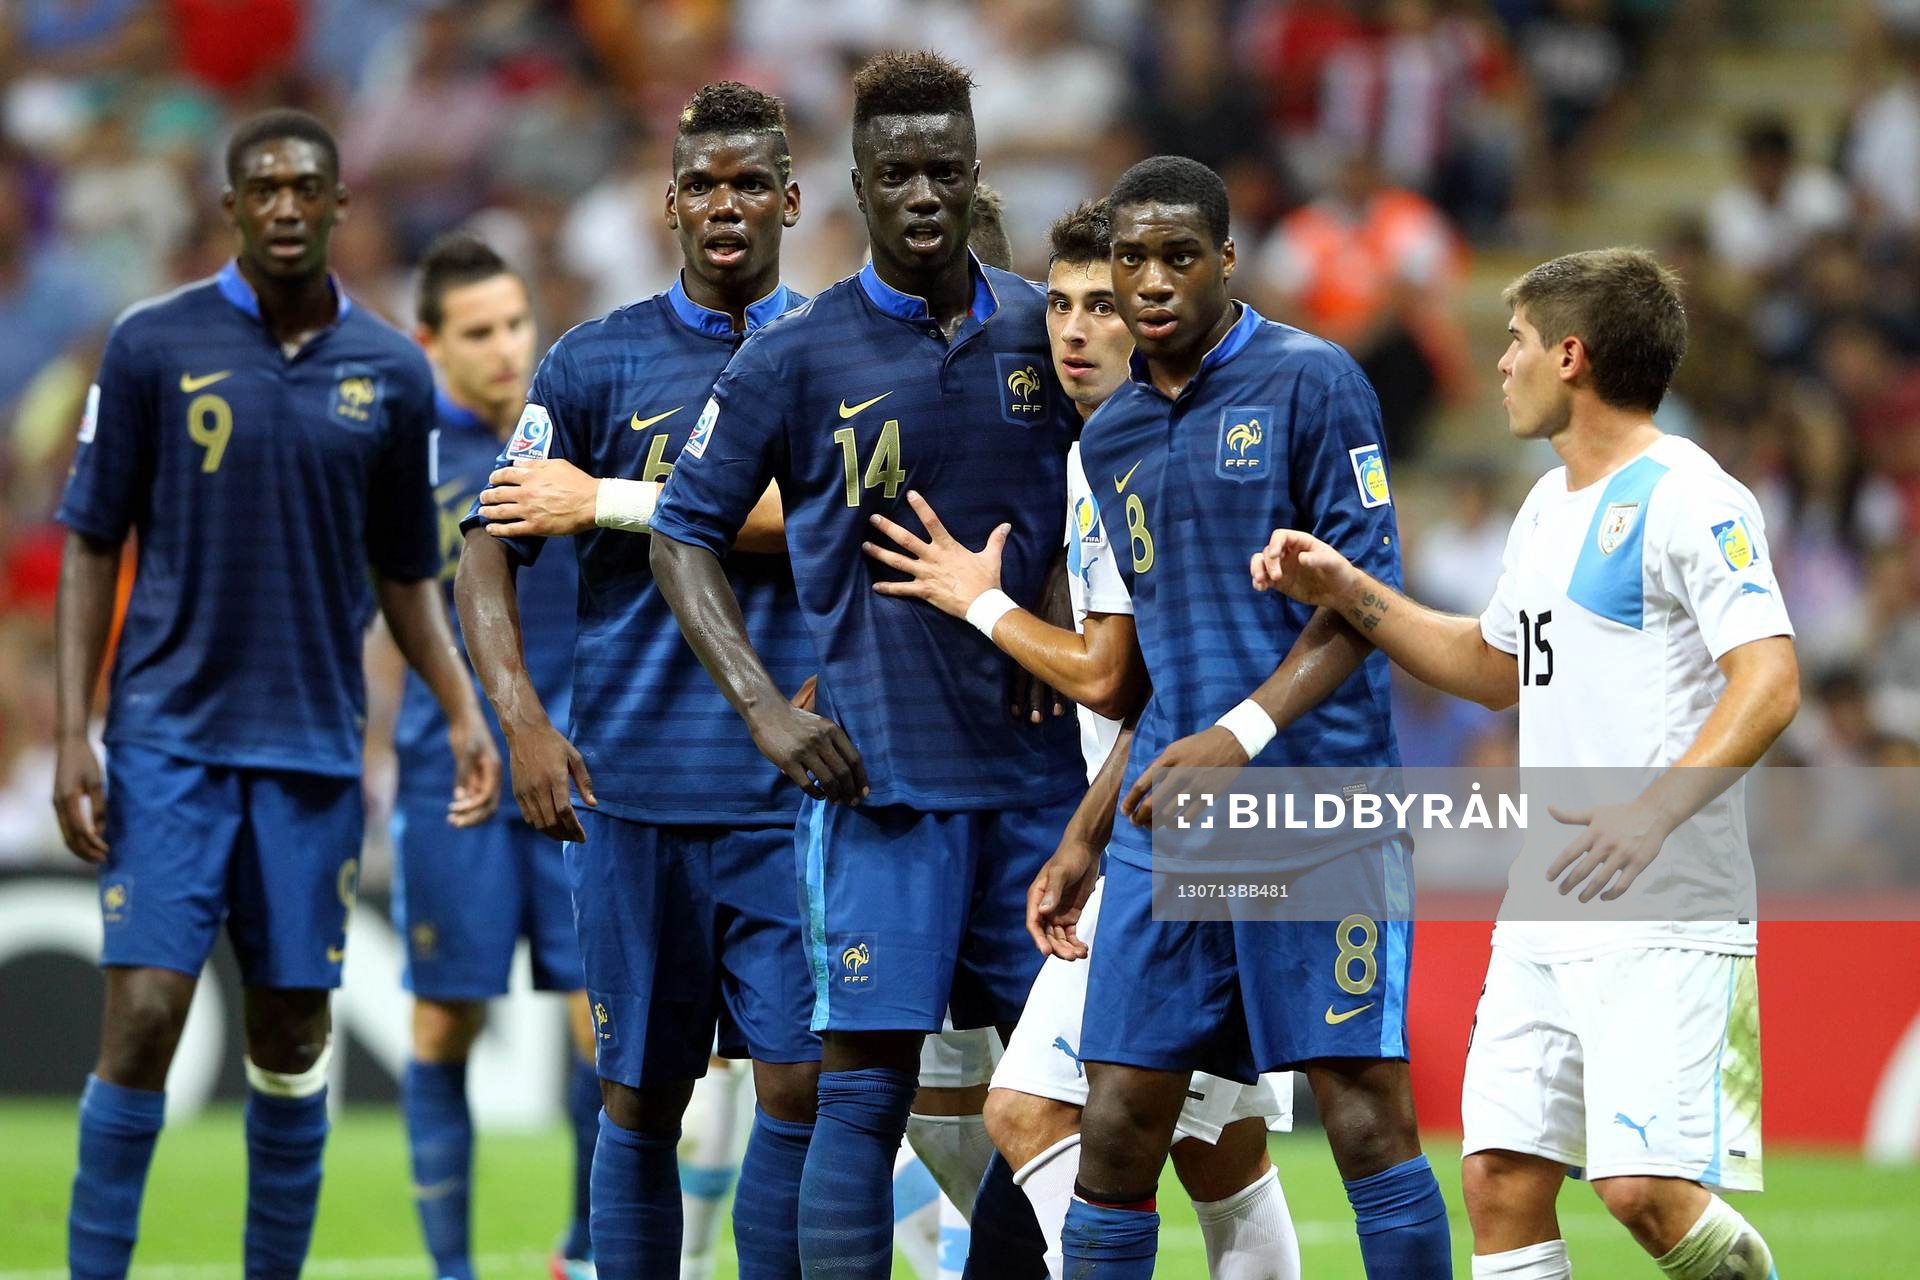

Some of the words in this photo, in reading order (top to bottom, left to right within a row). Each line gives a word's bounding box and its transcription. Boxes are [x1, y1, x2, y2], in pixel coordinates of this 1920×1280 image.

[187, 394, 234, 474] 9
[1012, 404, 1042, 413] FFF
[834, 420, 906, 507] 14
[1225, 459, 1260, 467] FFF
[1126, 493, 1154, 573] 8
[1519, 609, 1553, 686] 15
[1334, 914, 1378, 995] 8
